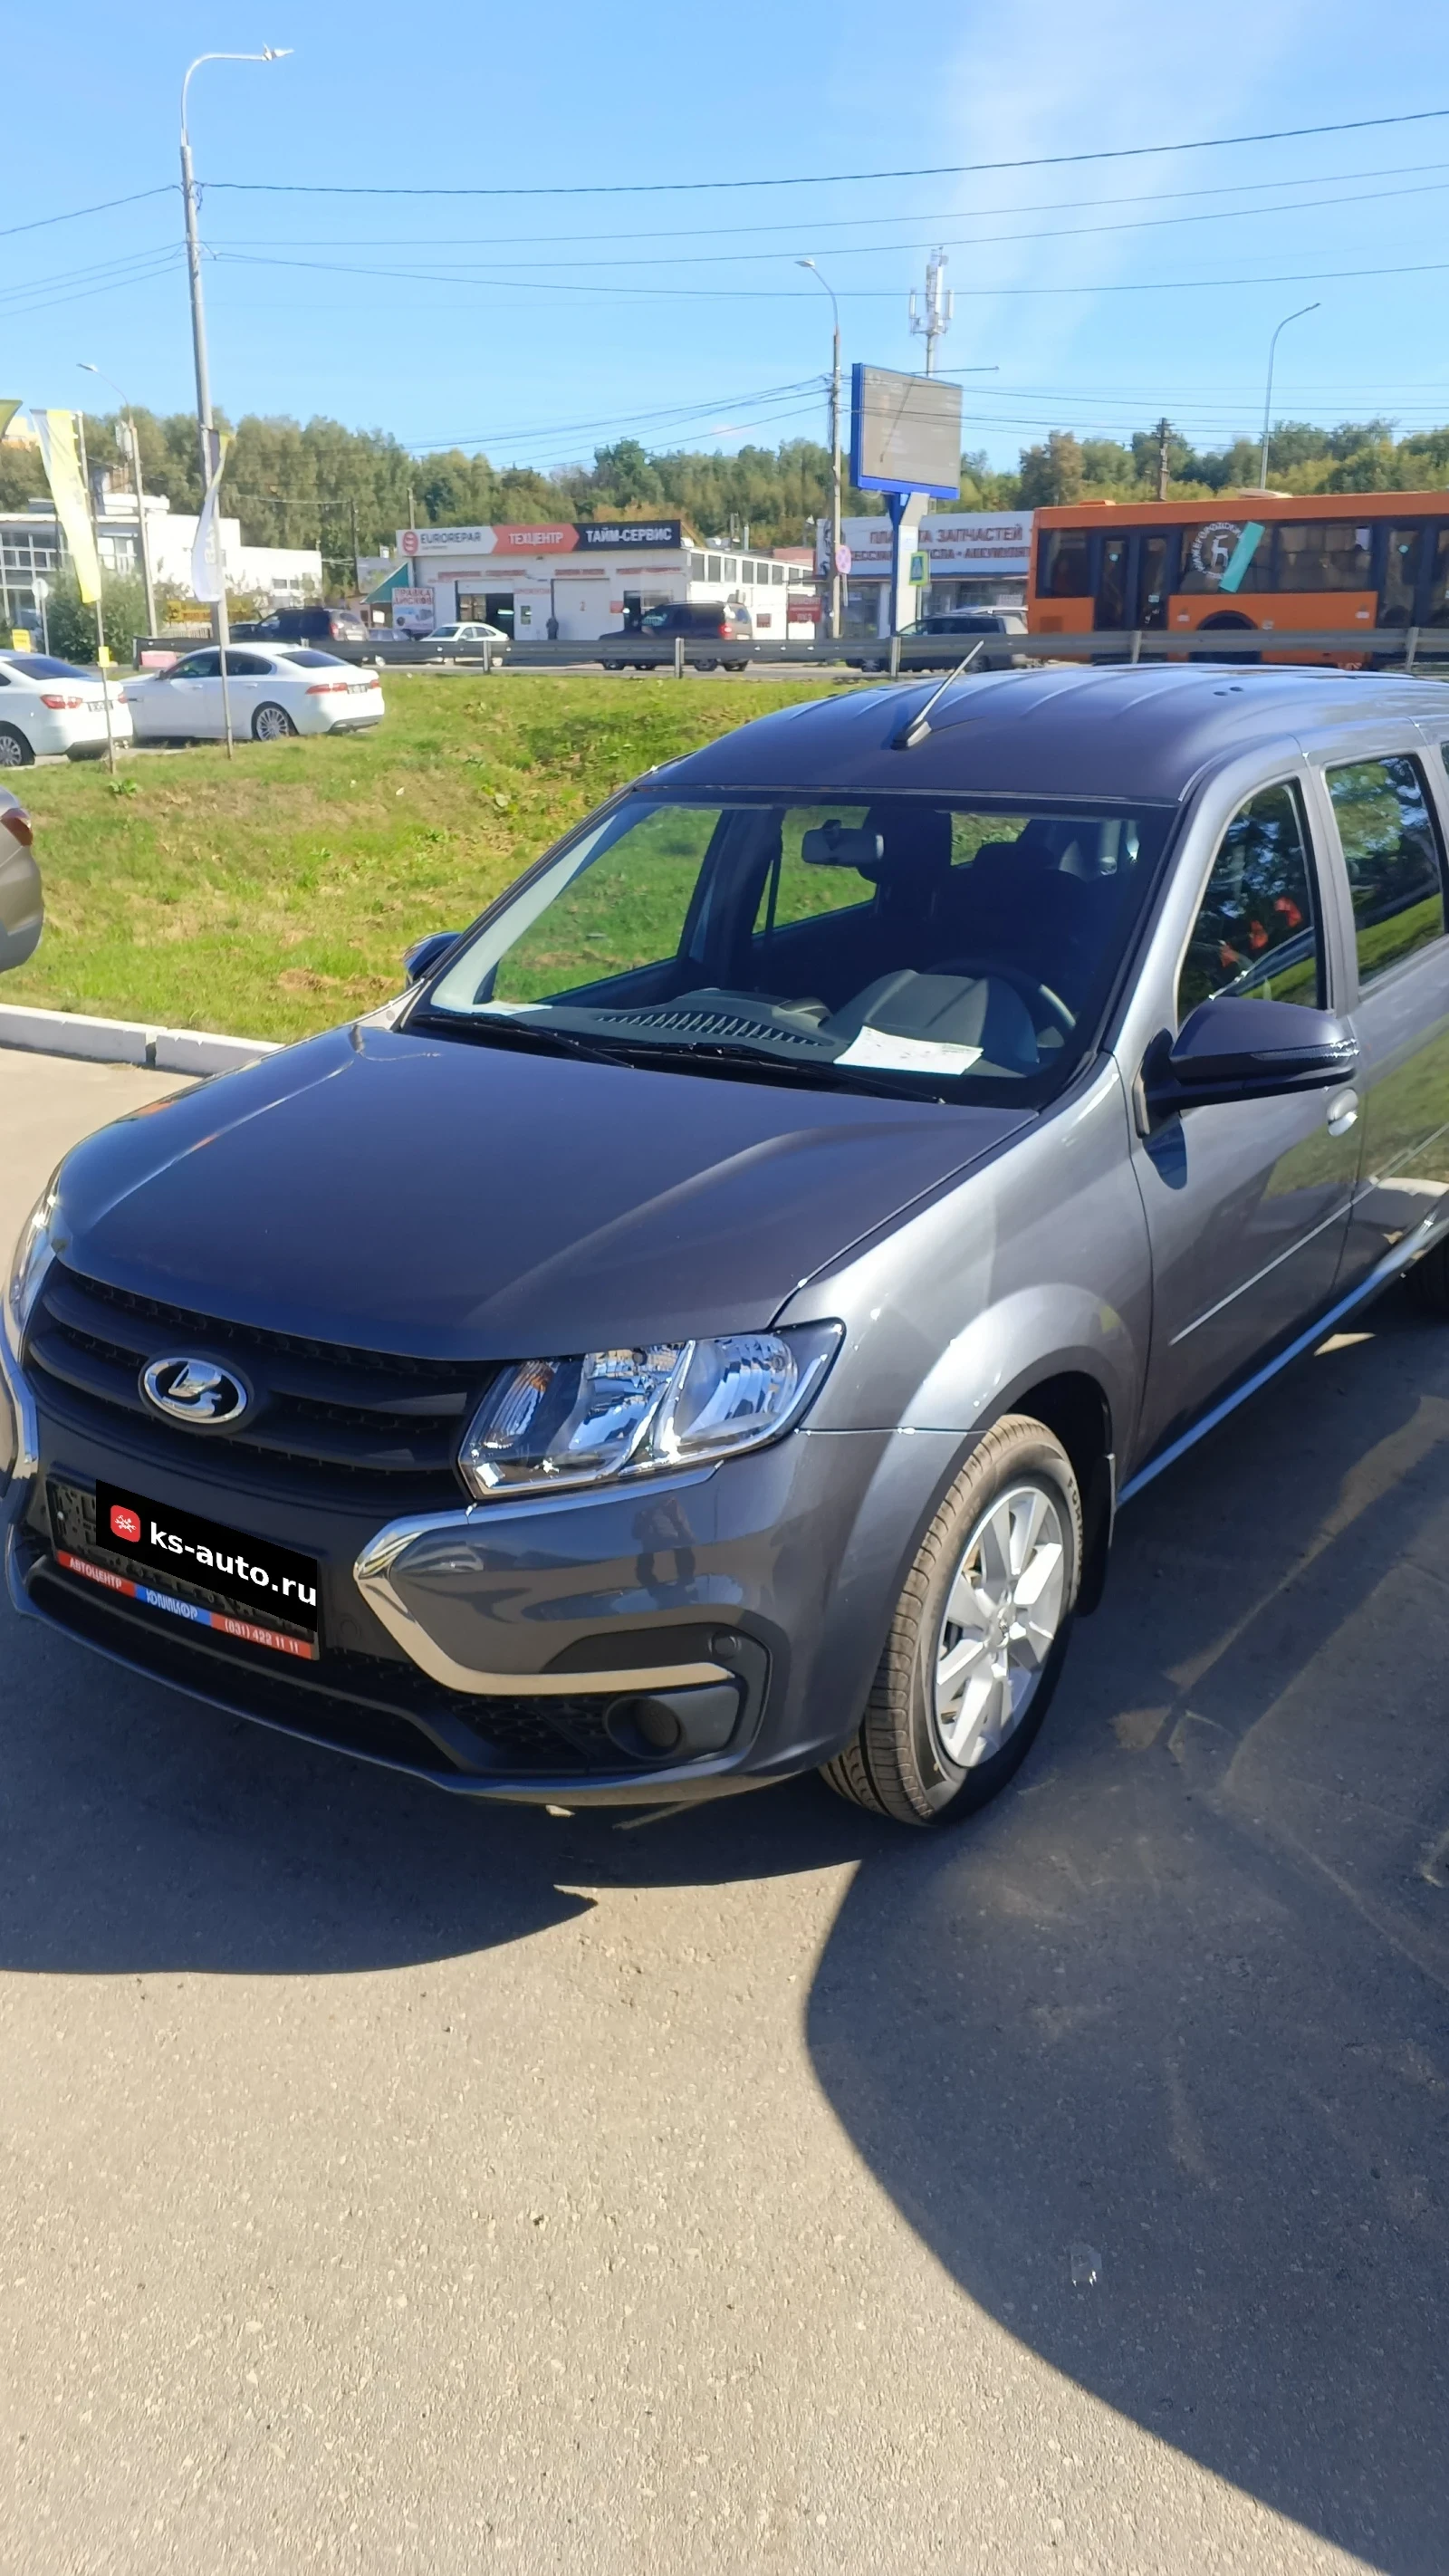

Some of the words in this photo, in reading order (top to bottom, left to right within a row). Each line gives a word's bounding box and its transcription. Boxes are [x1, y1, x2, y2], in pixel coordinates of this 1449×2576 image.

[420, 532, 482, 544] EUROREPAR
[509, 532, 563, 545] ТЕХЦЕНТР
[586, 527, 672, 543] ТАЙМ-СЕРВИС
[936, 524, 1022, 542] ЗАПЧАСТЕЙ
[70, 1557, 122, 1590] АВТОЦЕНТР
